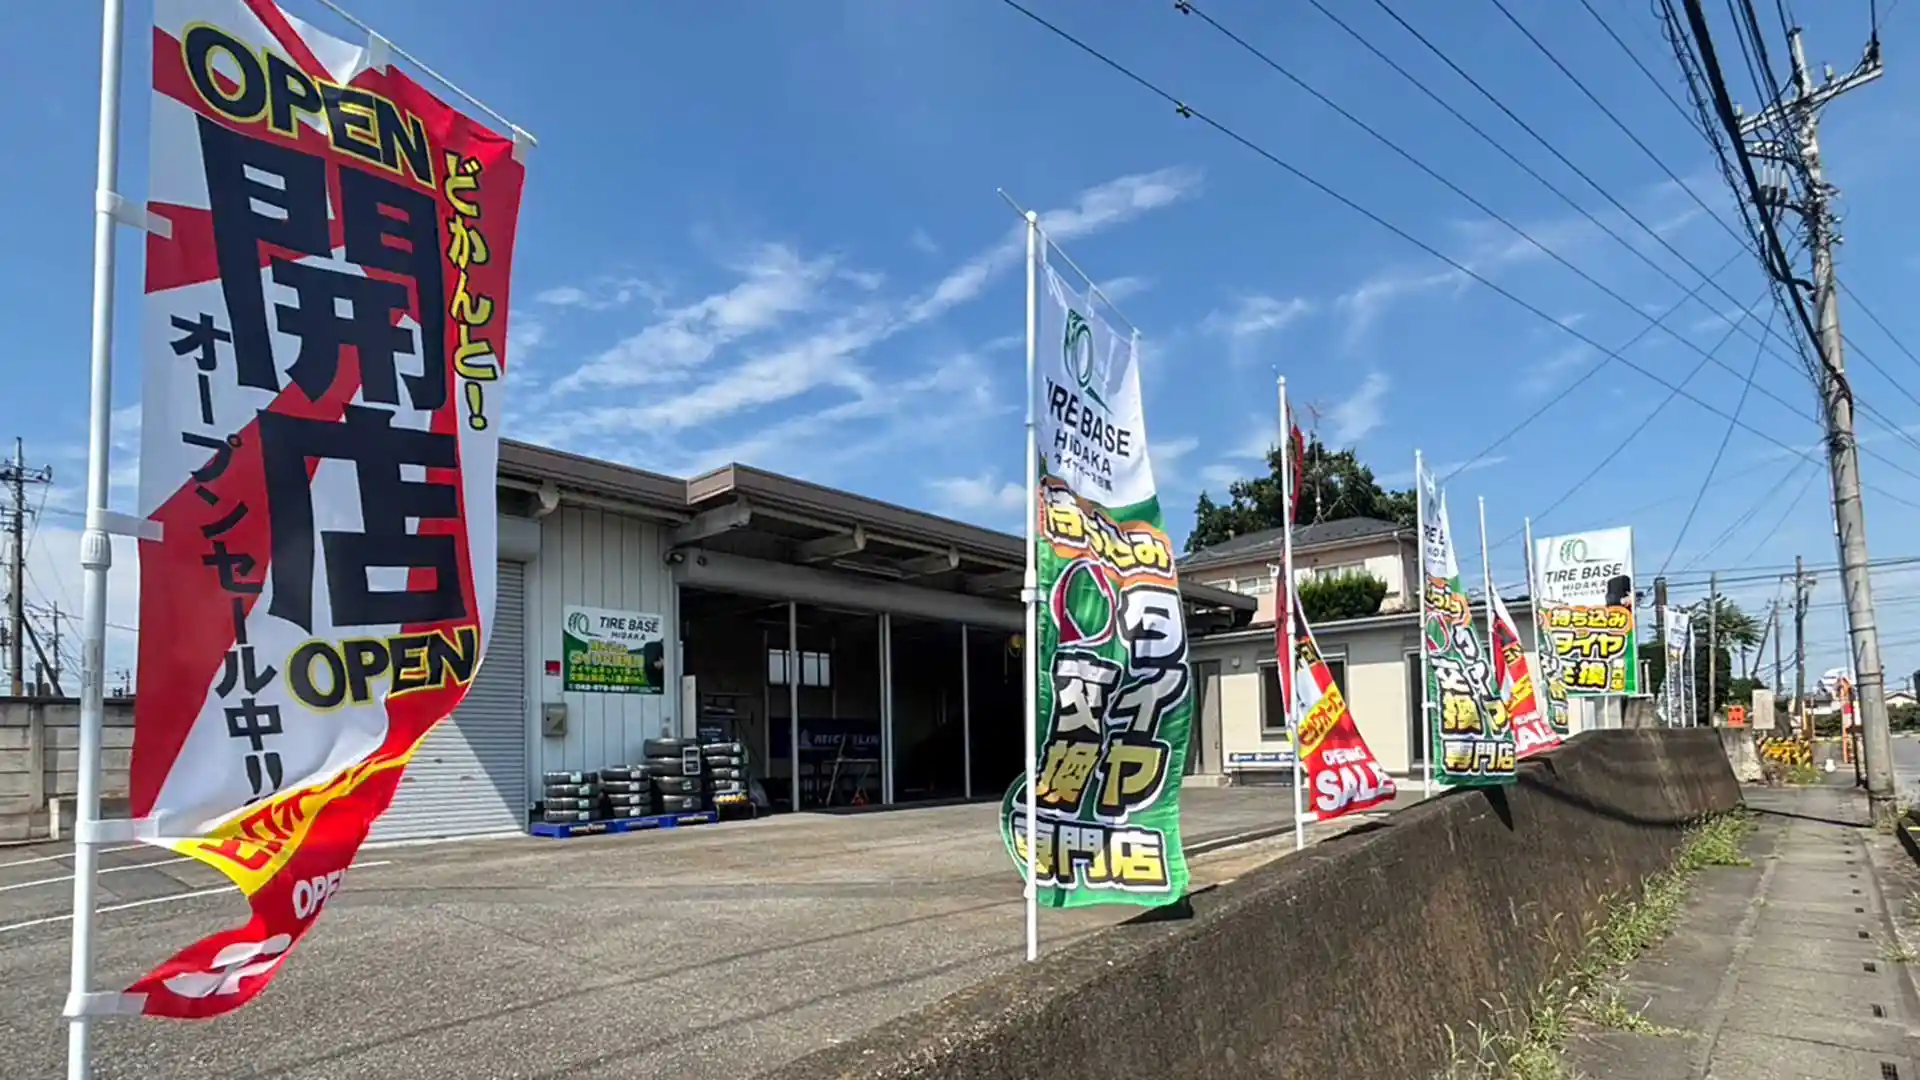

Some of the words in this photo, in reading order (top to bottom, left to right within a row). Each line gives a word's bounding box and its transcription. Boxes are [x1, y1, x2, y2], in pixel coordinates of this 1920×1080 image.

[182, 21, 436, 189] OPEN
[195, 112, 468, 634] 開店
[1053, 428, 1112, 477] HIDAKA
[1080, 405, 1132, 458] BASE
[1546, 568, 1578, 584] TIRE
[1582, 563, 1623, 581] BASE
[600, 616, 626, 630] TIRE
[628, 619, 659, 634] BASE
[1552, 608, 1627, 628] 持ち込み
[1555, 633, 1625, 656] タイヤ
[286, 626, 480, 713] OPEN
[1102, 589, 1185, 807] タイヤ
[1036, 656, 1119, 805] 交換
